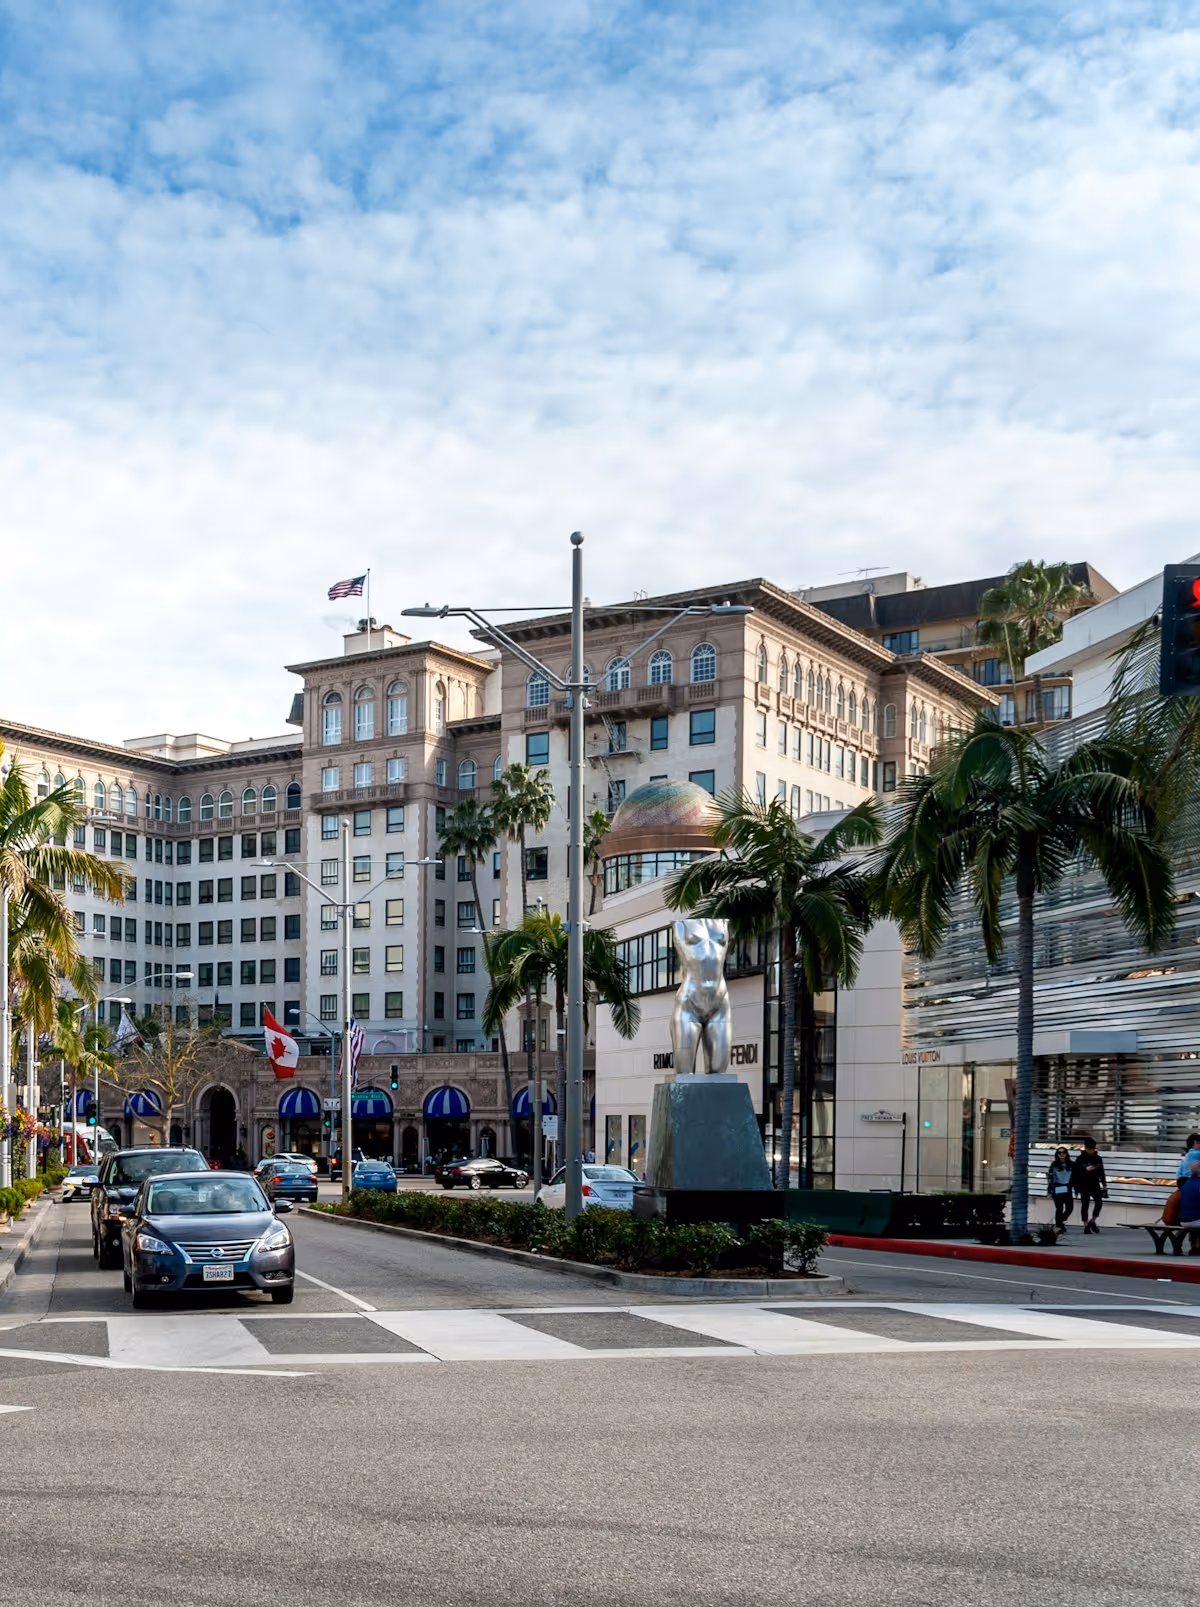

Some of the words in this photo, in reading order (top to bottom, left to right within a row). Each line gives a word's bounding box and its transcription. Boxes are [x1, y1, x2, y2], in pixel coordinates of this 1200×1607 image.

[730, 1043, 758, 1065] FENDI
[902, 1052, 917, 1065] LOUIS
[917, 1050, 941, 1063] VUITTON
